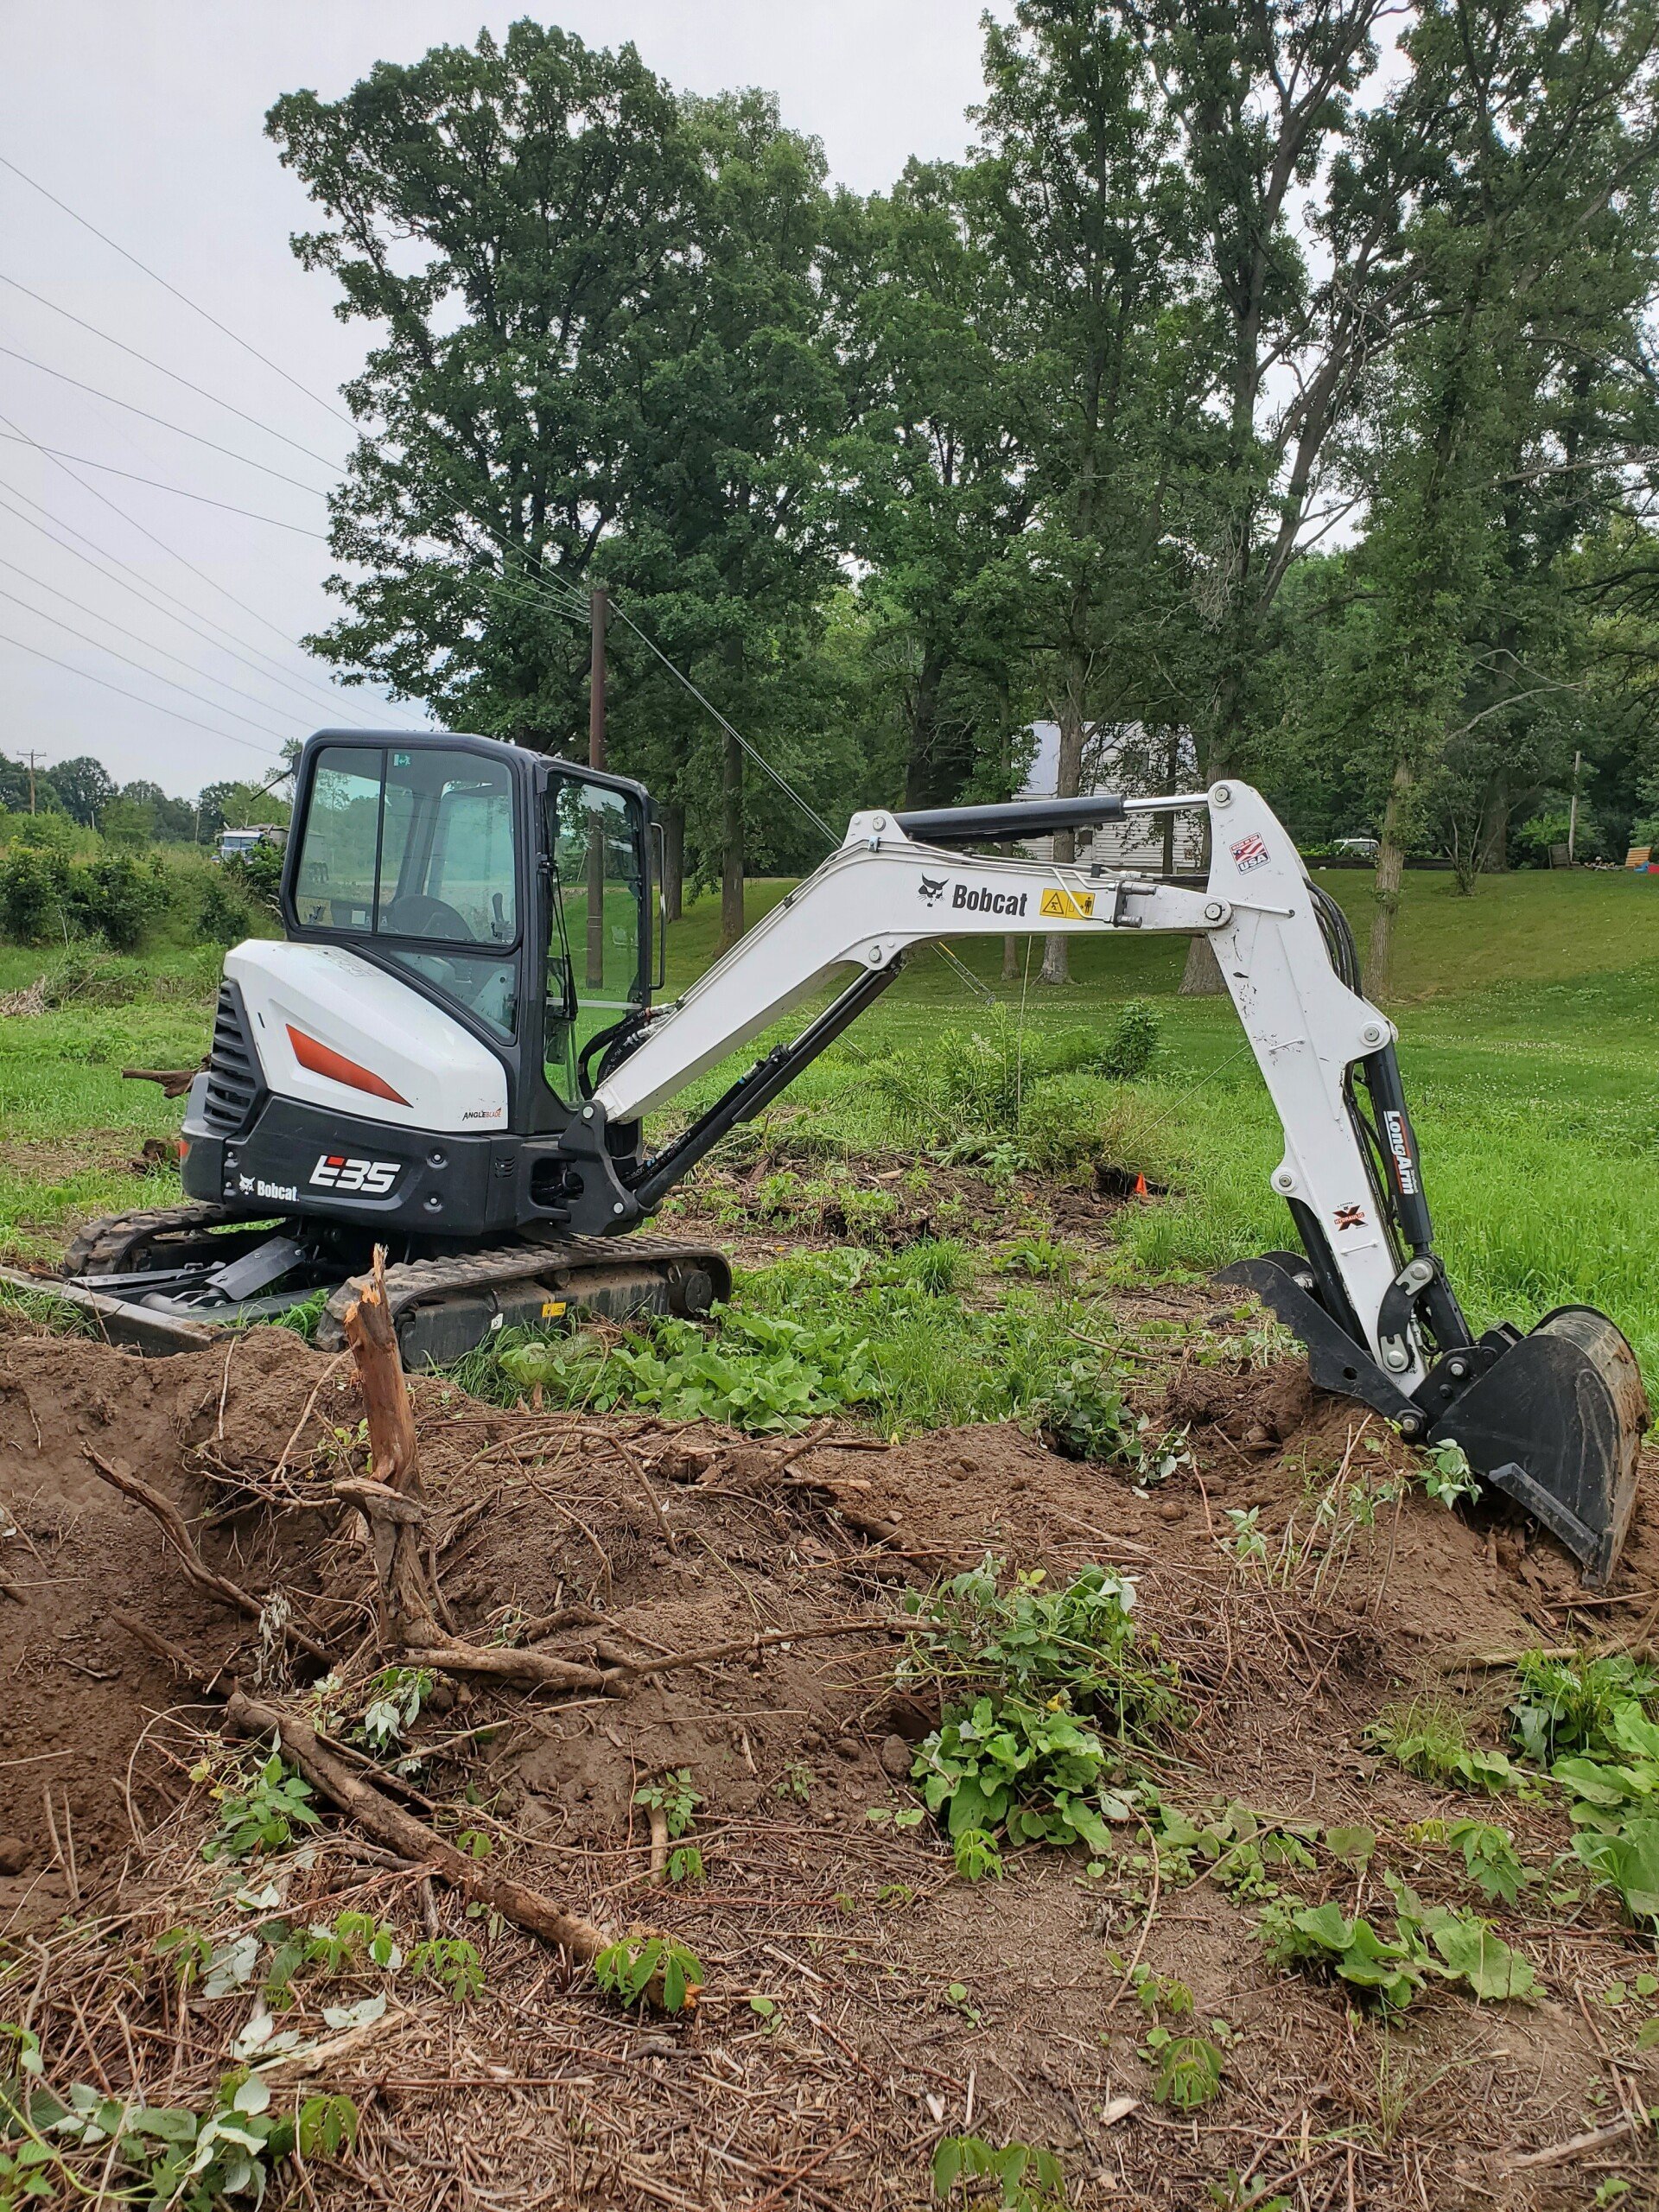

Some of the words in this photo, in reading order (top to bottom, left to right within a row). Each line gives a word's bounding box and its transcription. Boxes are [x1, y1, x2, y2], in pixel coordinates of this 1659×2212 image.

[1239, 853, 1268, 871] USA
[952, 884, 1027, 917] Bobcat
[461, 1107, 502, 1122] ANGLEBLADE
[1383, 1110, 1414, 1195] LongArm
[308, 1154, 402, 1193] E35
[257, 1180, 298, 1202] Bobcat
[1334, 1211, 1364, 1224] HYDRAULIC
